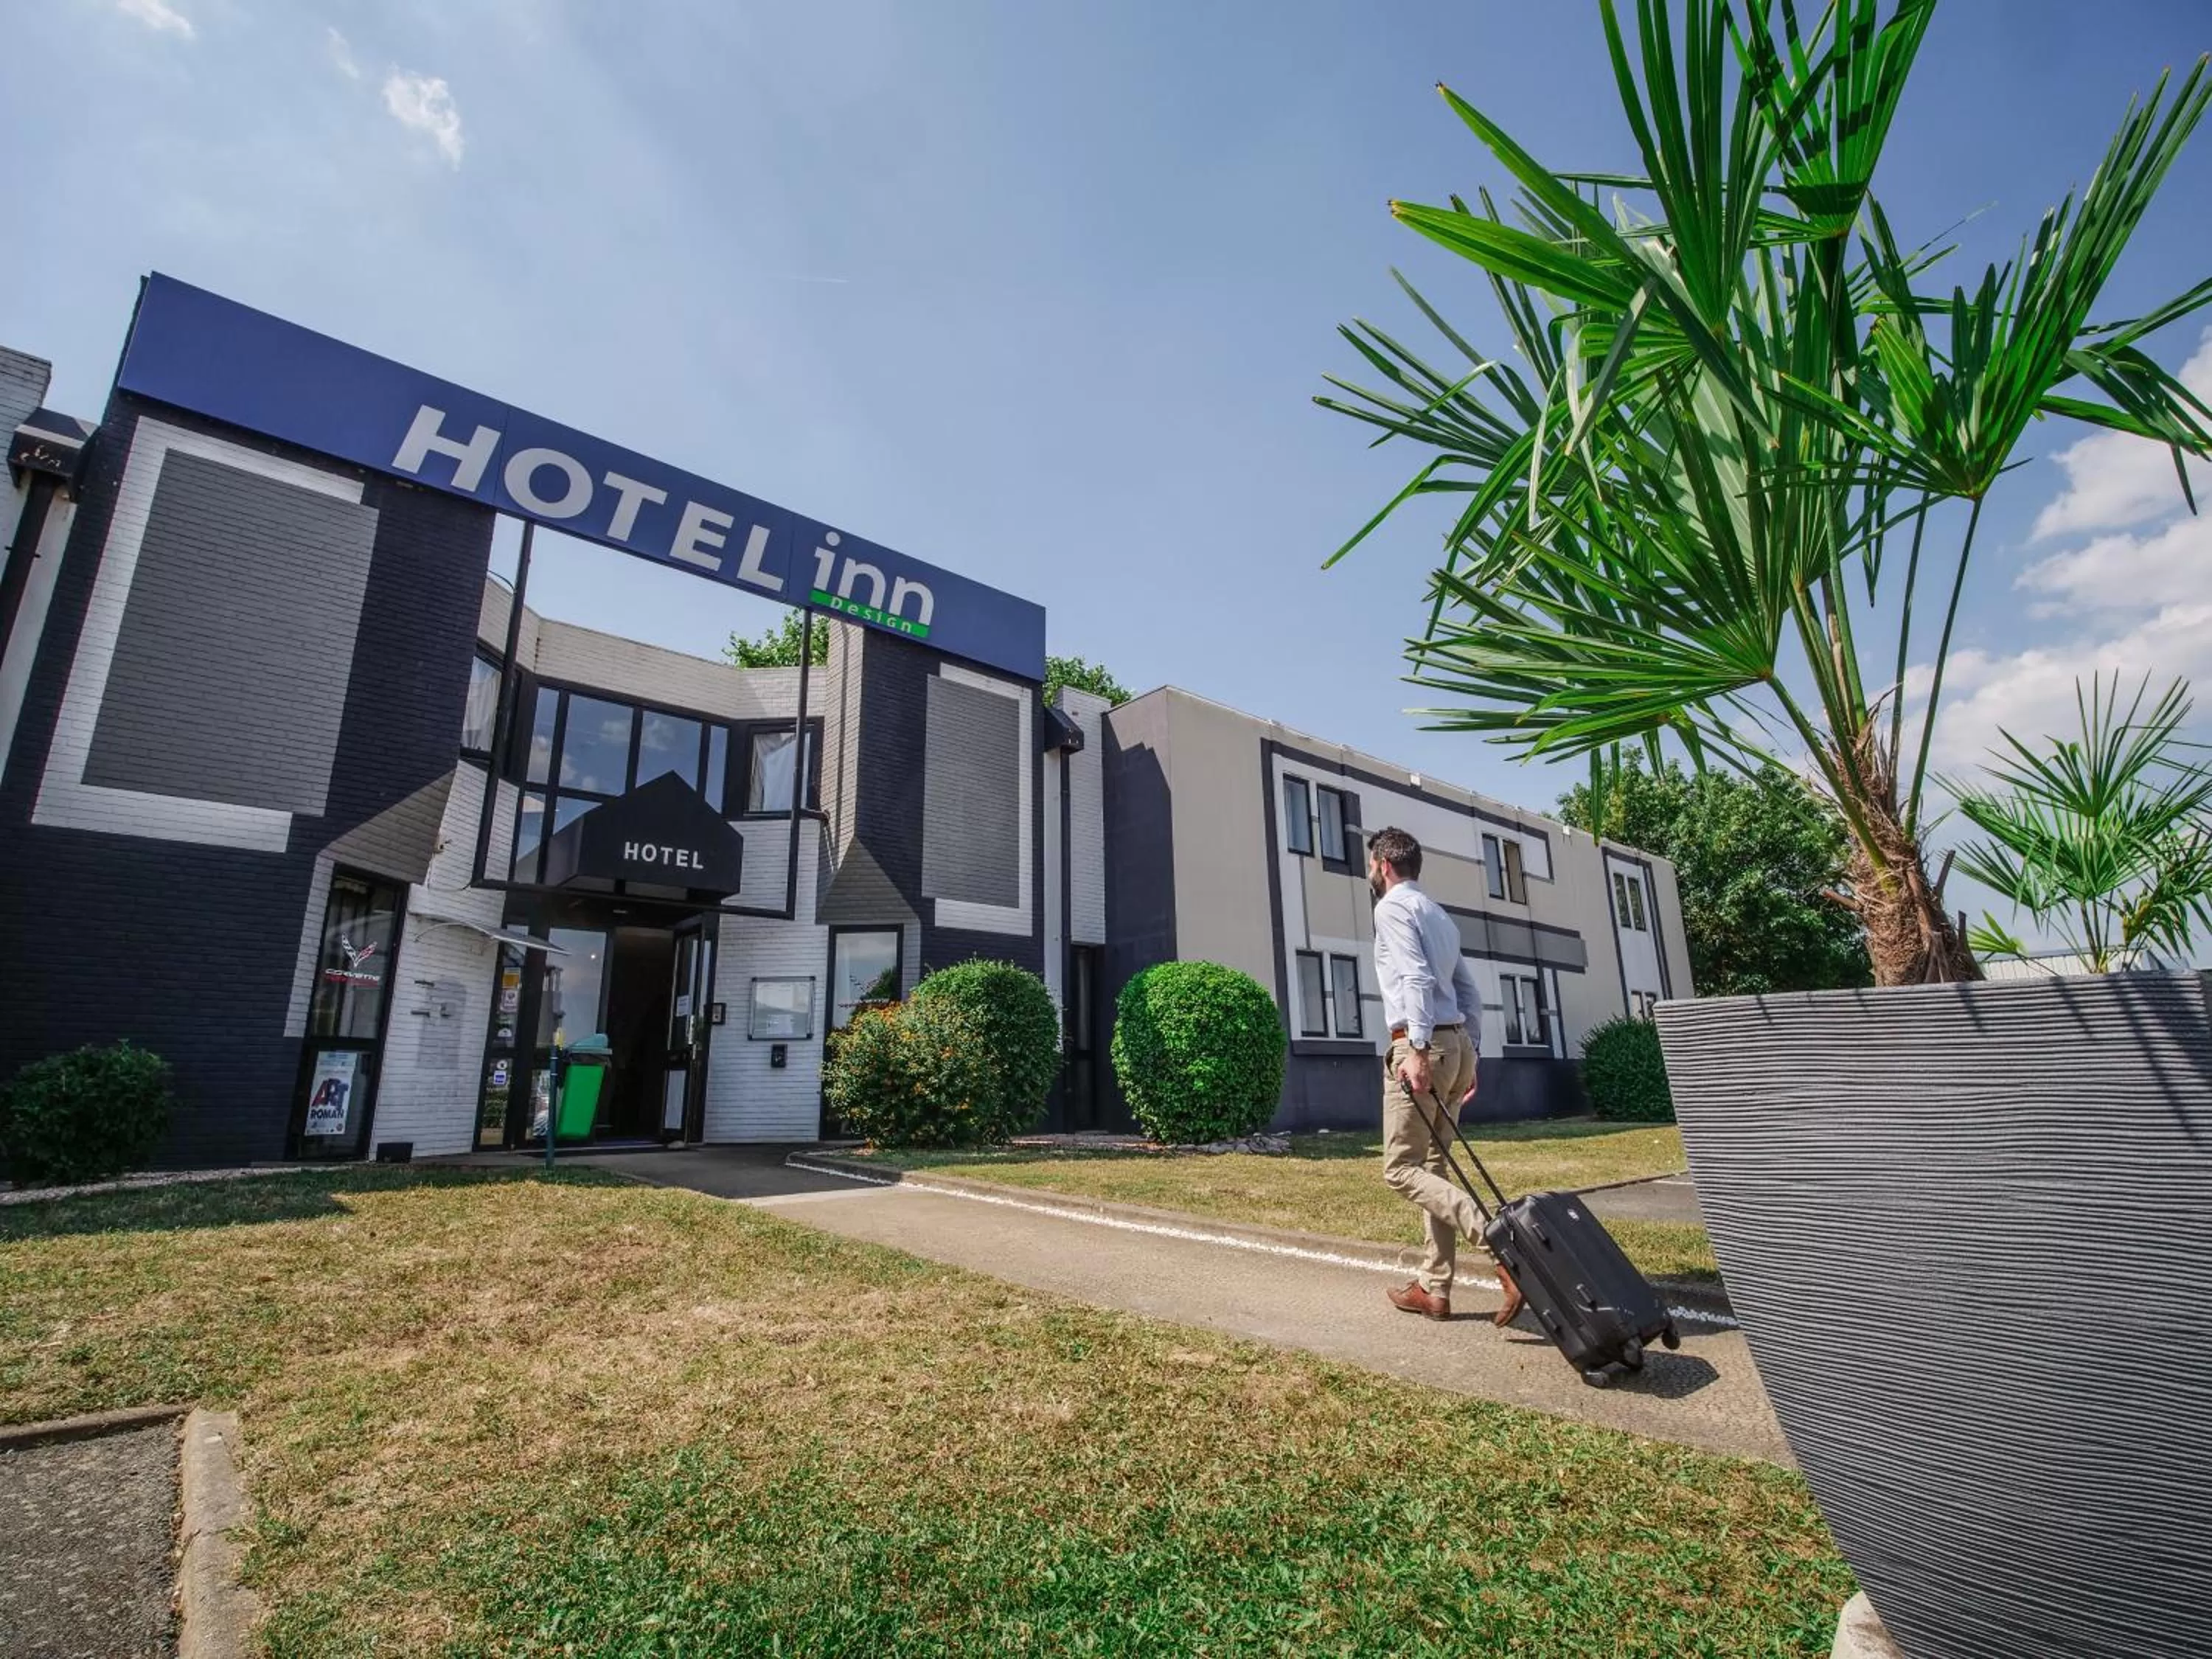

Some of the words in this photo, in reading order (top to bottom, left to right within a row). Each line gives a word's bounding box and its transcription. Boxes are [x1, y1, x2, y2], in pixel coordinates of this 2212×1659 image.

[391, 404, 785, 592] HOTEL
[813, 531, 935, 626] inn
[624, 841, 704, 869] HOTEL
[310, 1108, 344, 1119] ROMAN
